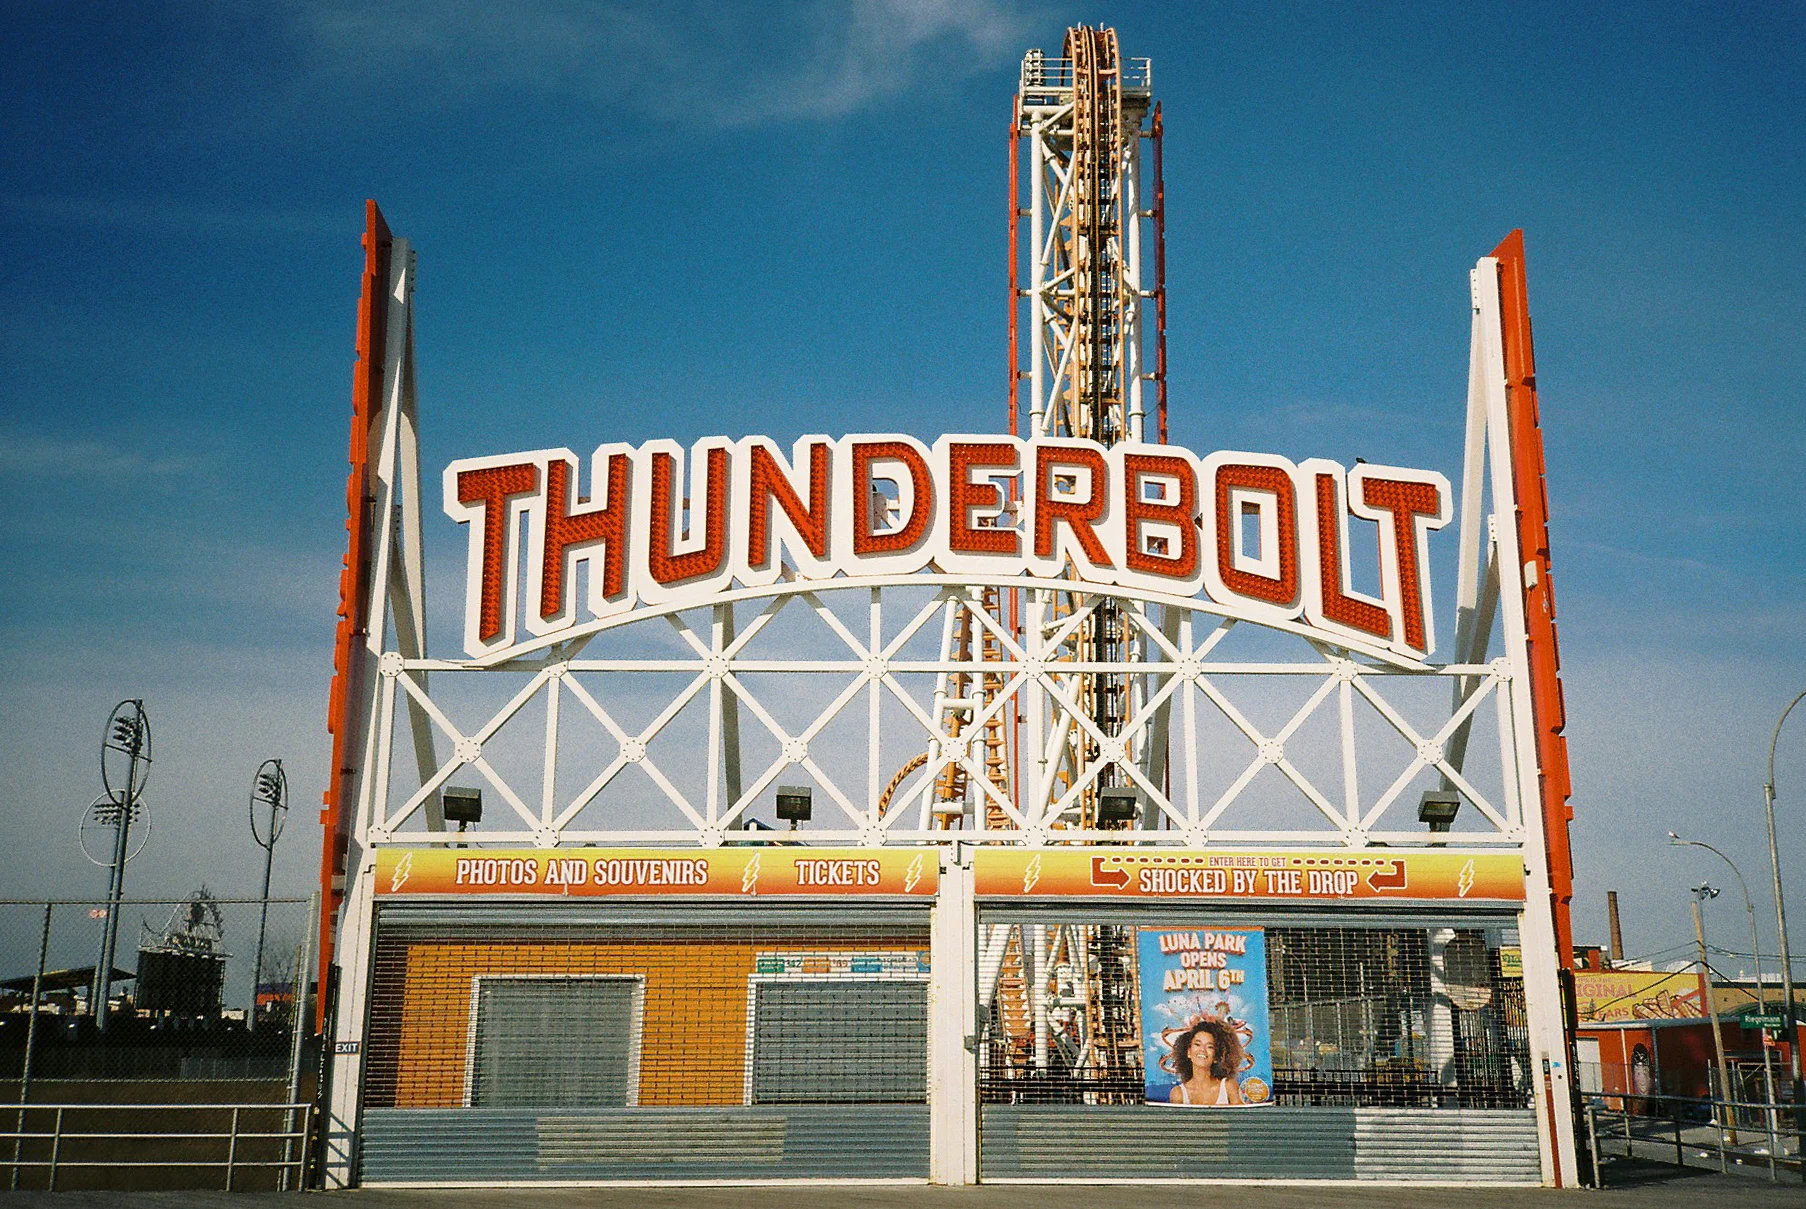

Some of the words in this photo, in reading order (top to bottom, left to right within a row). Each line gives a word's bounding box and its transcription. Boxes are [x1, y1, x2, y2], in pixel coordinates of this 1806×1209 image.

[446, 434, 1452, 664] THUNDERBOLT
[456, 859, 537, 885] PHOTOS
[544, 859, 587, 885] AND
[594, 859, 708, 885] SOUVENIRS
[795, 860, 880, 885] TICKETS
[1209, 857, 1234, 866] ENTER
[1236, 857, 1256, 867] HERE
[1259, 858, 1269, 867] TO
[1271, 858, 1286, 867] GET
[1139, 868, 1226, 893] SHOCKED
[1232, 869, 1257, 893] BY
[1264, 870, 1302, 894] THE
[1309, 870, 1358, 895] DROP
[1159, 933, 1201, 954] LUNA
[1204, 932, 1247, 955] PARK
[1180, 952, 1227, 969] OPENS
[1163, 969, 1214, 991] APRIL
[1576, 983, 1637, 998] IGINAL
[335, 1043, 358, 1053] EXIT
